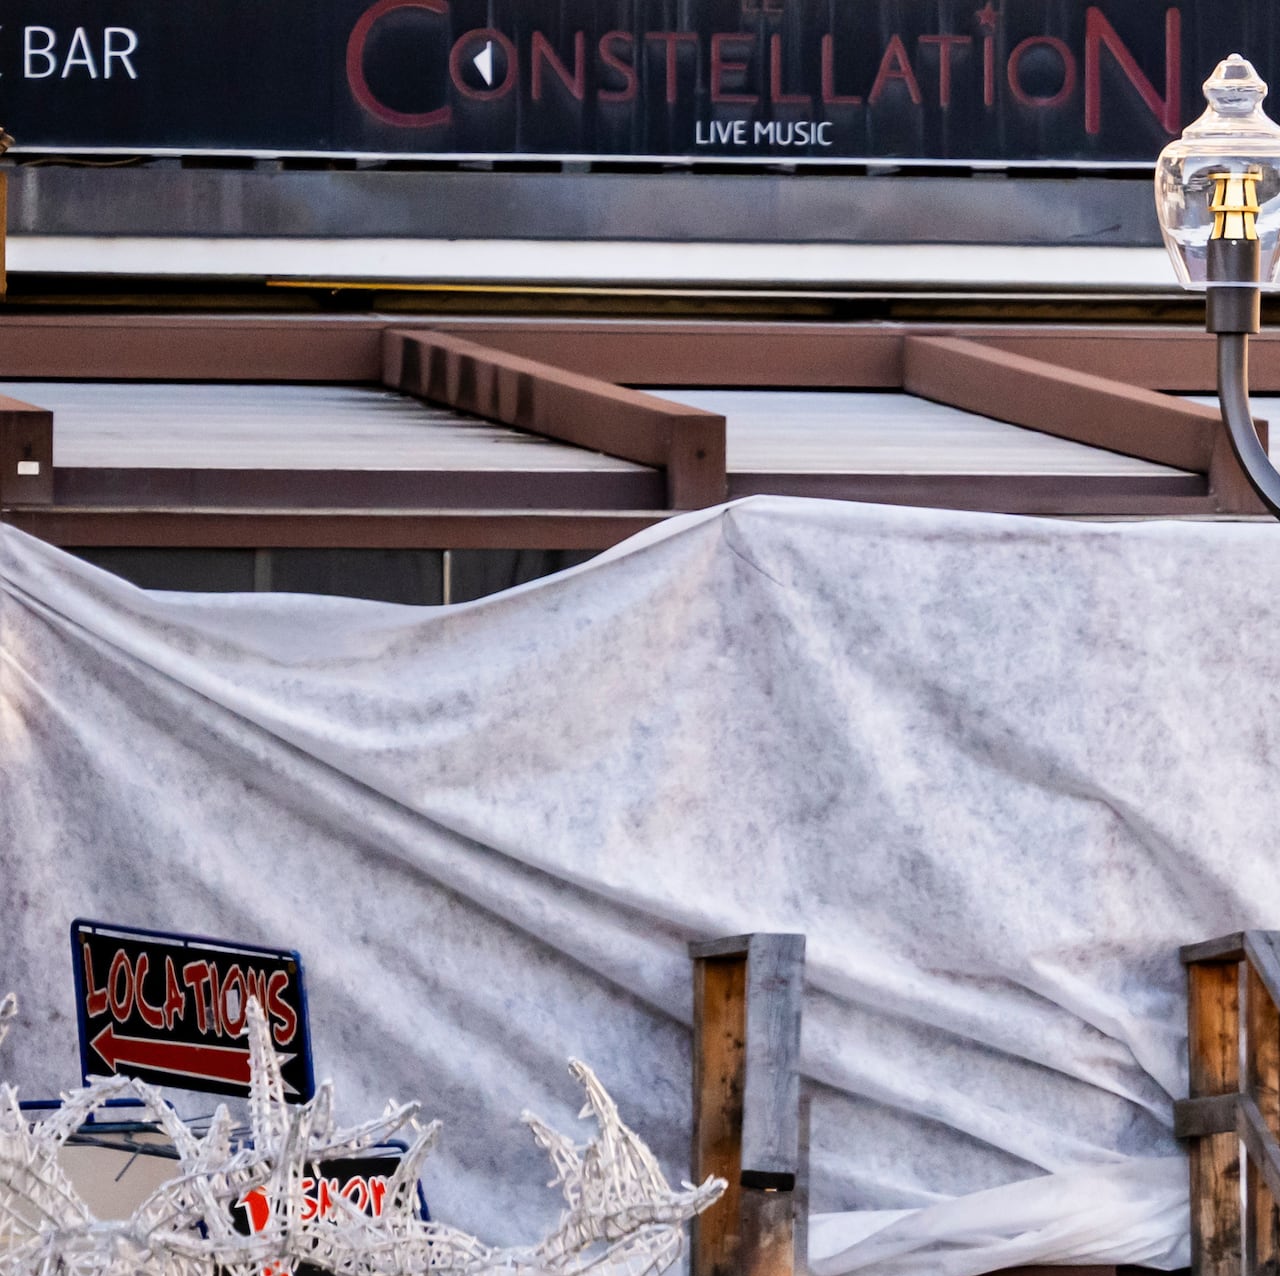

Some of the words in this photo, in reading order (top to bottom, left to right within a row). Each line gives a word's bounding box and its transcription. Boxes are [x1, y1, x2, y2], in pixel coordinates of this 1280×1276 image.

[23, 26, 138, 79] BAR
[695, 120, 747, 145] LIVE
[754, 121, 833, 146] MUSIC
